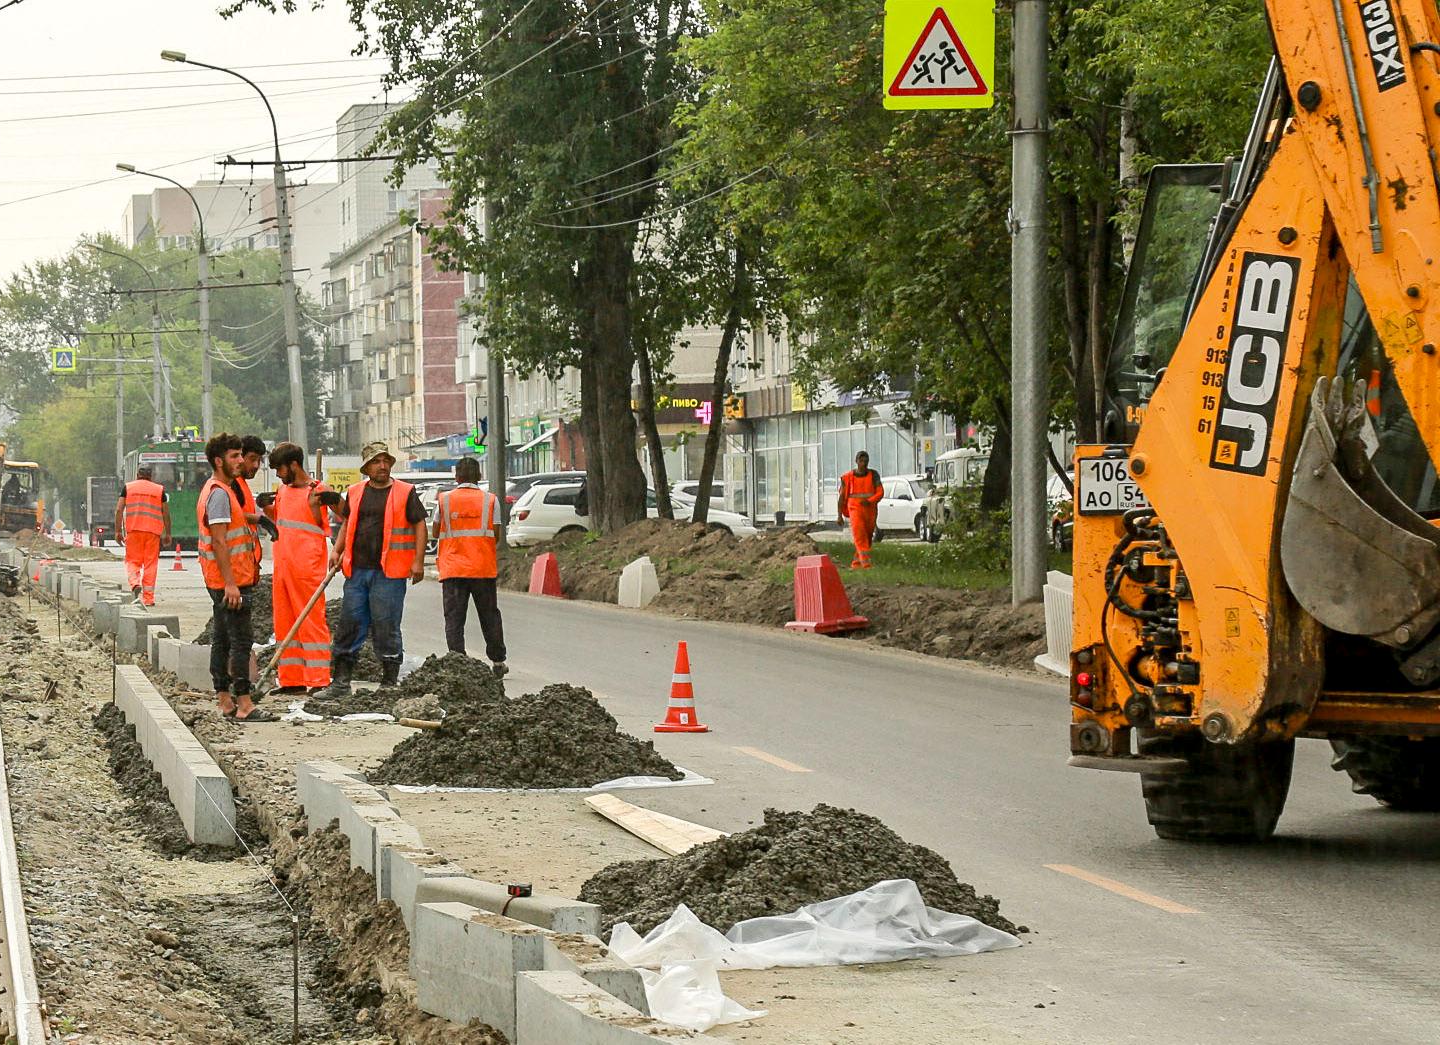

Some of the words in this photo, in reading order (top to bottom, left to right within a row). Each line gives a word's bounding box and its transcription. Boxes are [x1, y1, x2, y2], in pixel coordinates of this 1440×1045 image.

[1363, 0, 1405, 77] 3CX
[1216, 325, 1225, 340] 8
[1205, 347, 1228, 365] 913
[1220, 260, 1294, 468] JCB
[1201, 371, 1224, 388] 913
[672, 398, 698, 408] ПИВО
[1202, 395, 1216, 411] 15
[1198, 418, 1212, 434] 61
[1090, 461, 1134, 482] 106
[1085, 491, 1112, 507] АО
[1124, 485, 1144, 502] 54
